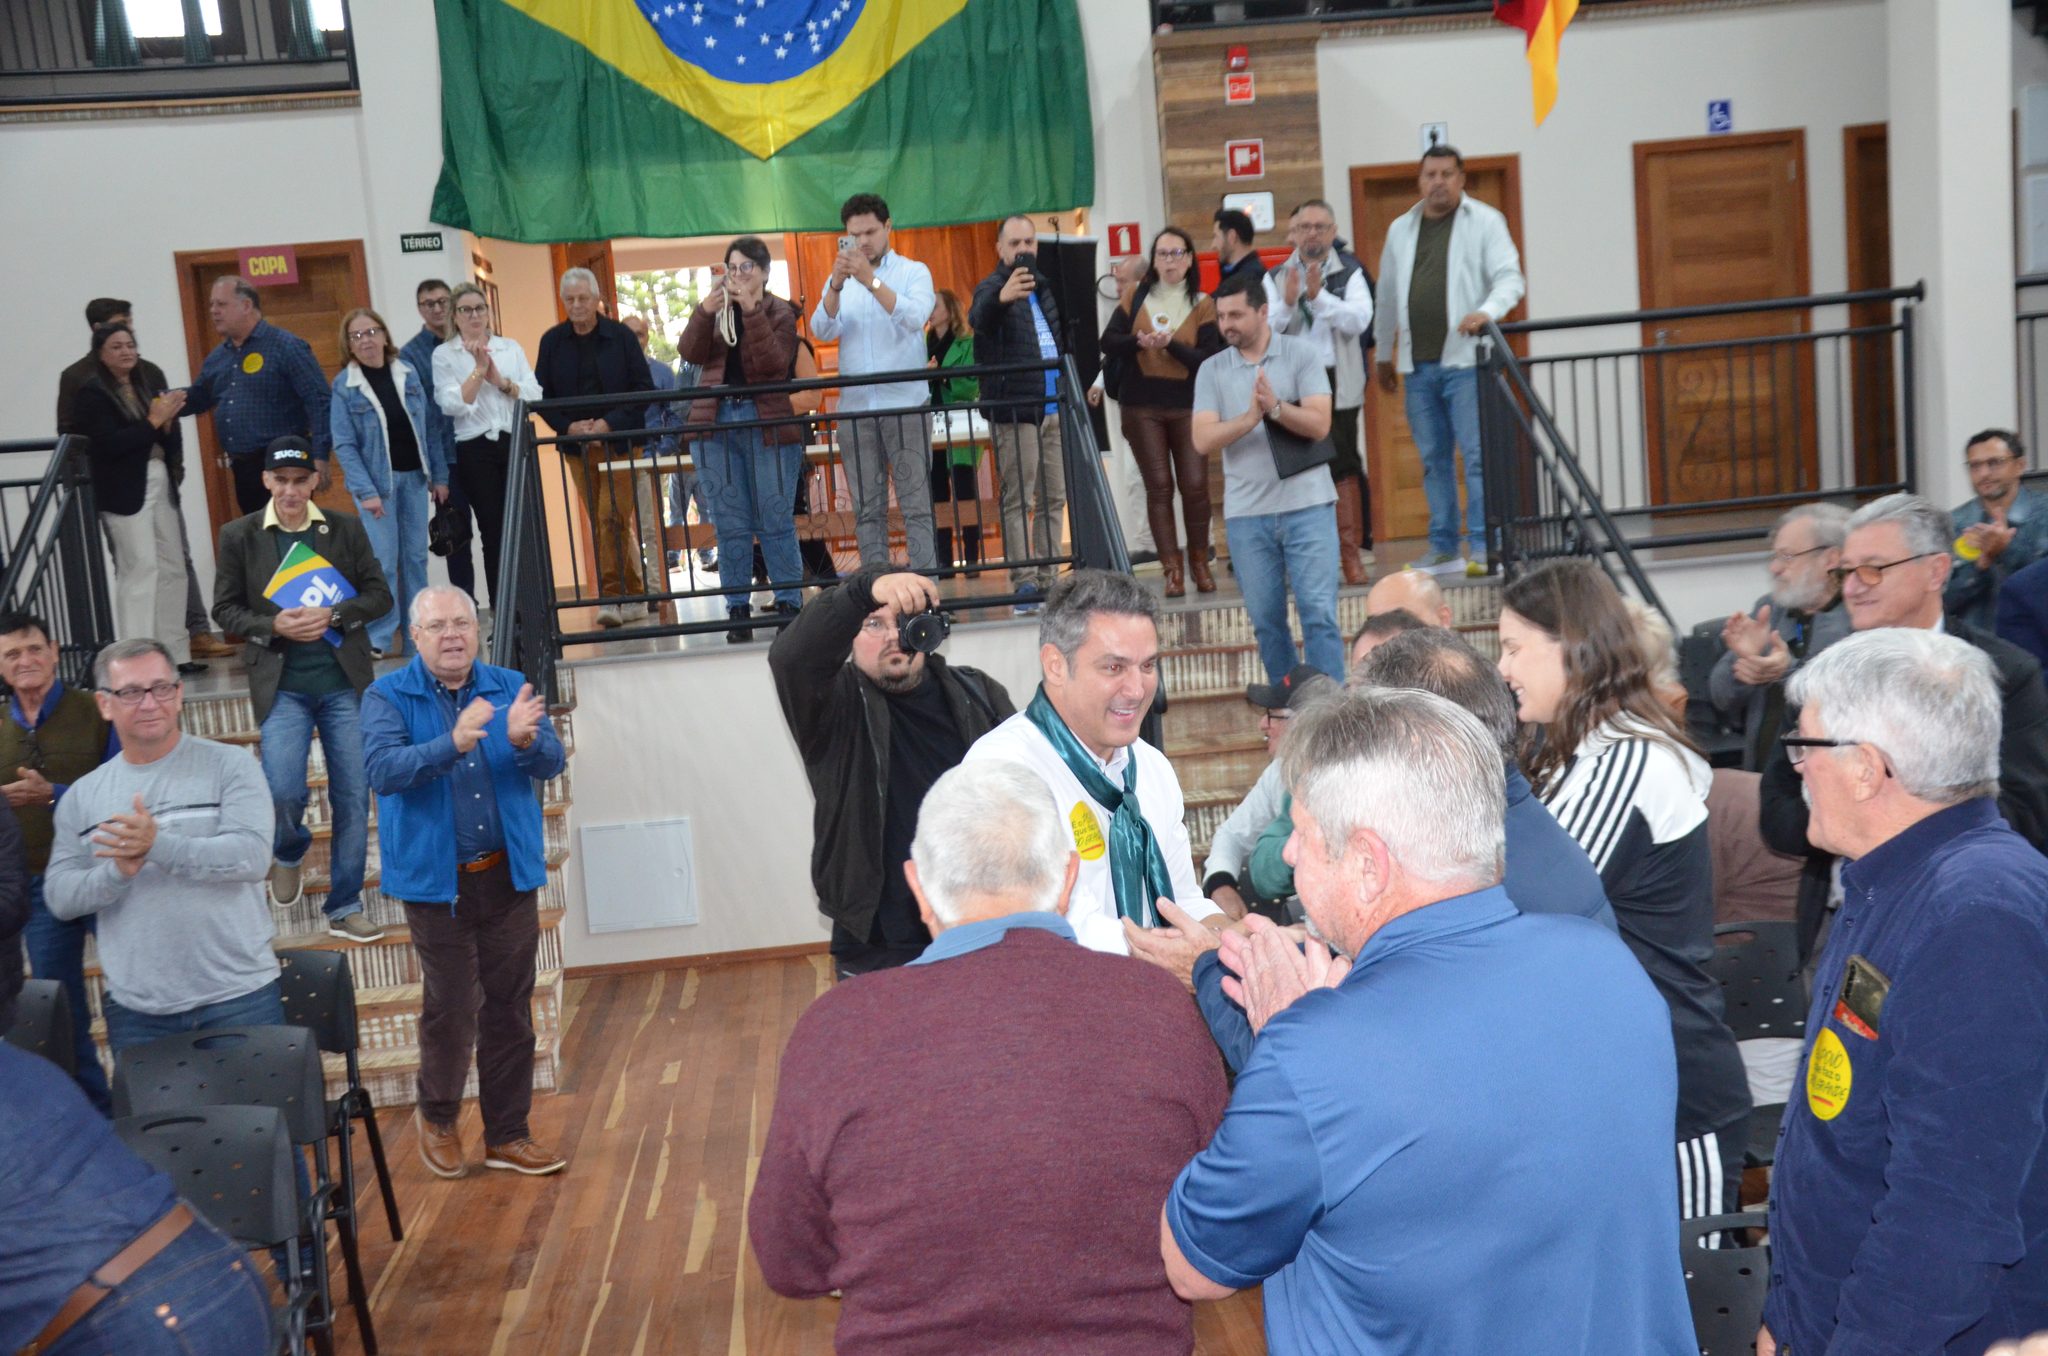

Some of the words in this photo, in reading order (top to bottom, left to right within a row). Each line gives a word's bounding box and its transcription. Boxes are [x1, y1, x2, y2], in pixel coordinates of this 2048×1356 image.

[402, 236, 441, 250] TÉRREO
[248, 255, 288, 276] COPA
[299, 574, 338, 607] PL
